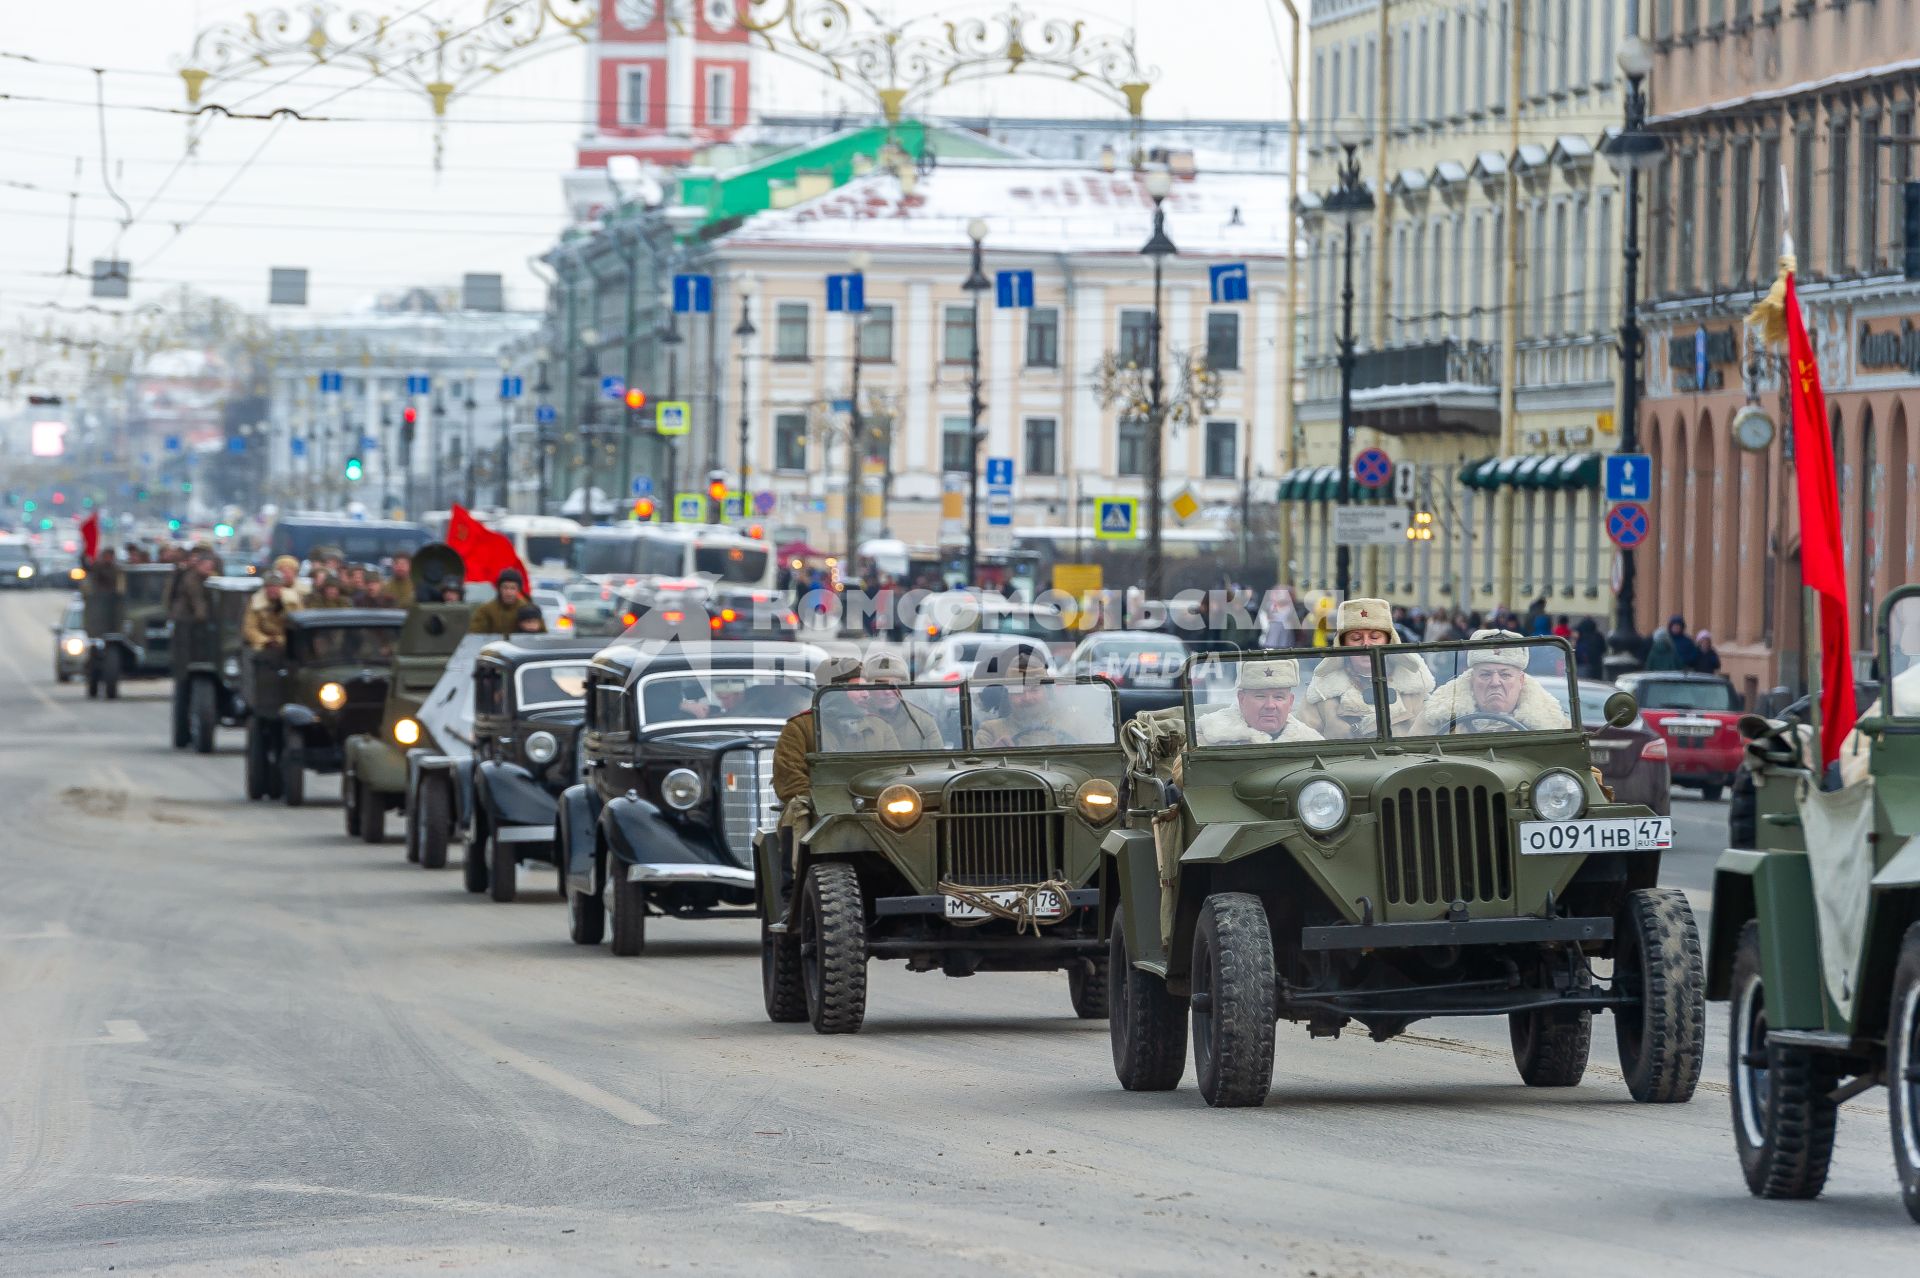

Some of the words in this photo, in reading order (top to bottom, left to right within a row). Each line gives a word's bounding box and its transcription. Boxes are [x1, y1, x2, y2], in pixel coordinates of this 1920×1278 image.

[1530, 824, 1631, 850] О091НВ
[1638, 820, 1662, 839] 47
[1637, 839, 1656, 847] RUS
